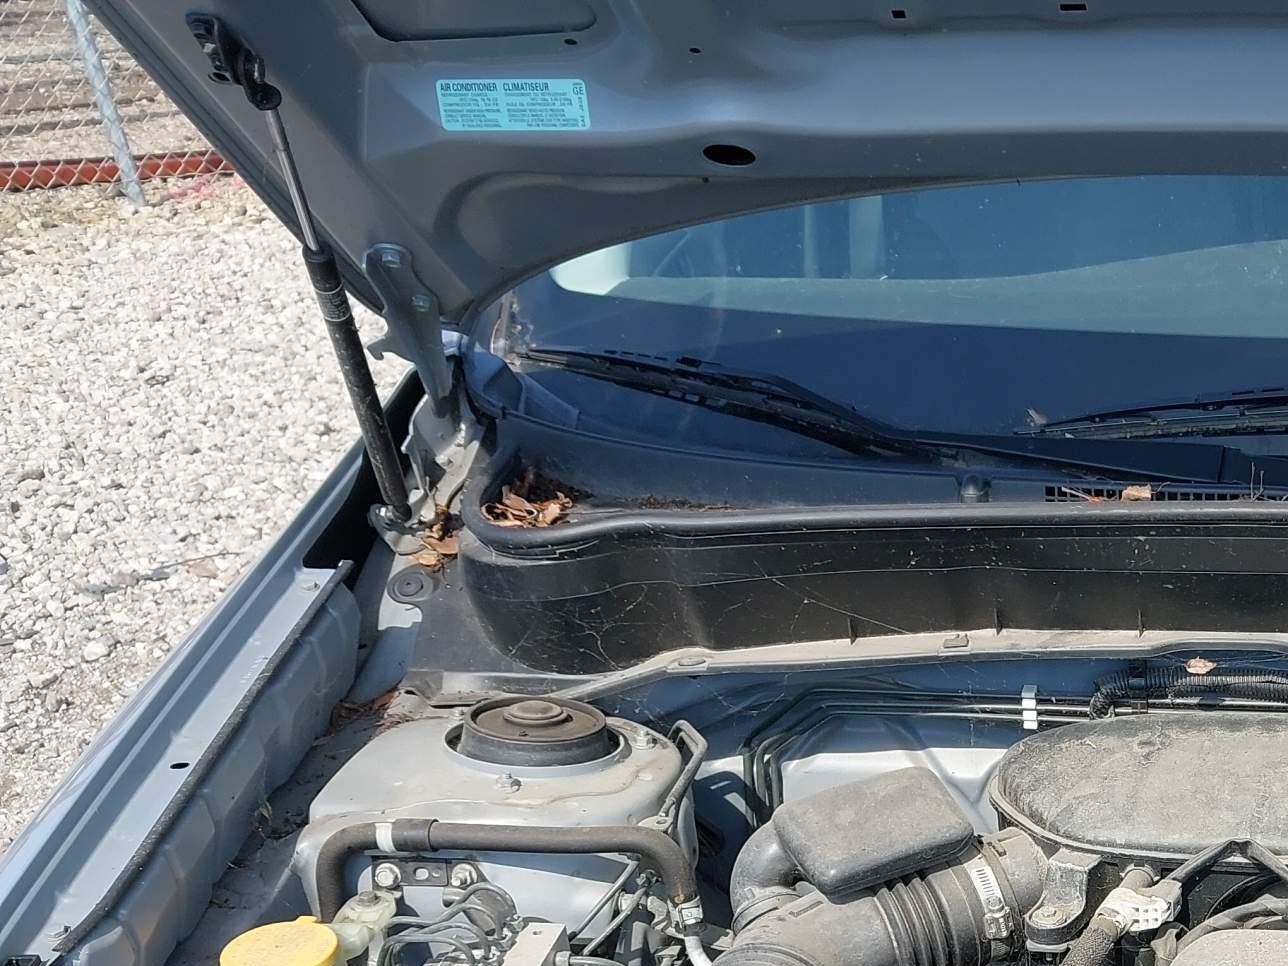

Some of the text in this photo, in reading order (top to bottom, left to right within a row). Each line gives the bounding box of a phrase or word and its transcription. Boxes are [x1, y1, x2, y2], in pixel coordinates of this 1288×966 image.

[440, 82, 497, 92] AIR CONDITIONER
[503, 82, 549, 92] CLIMATISEUR
